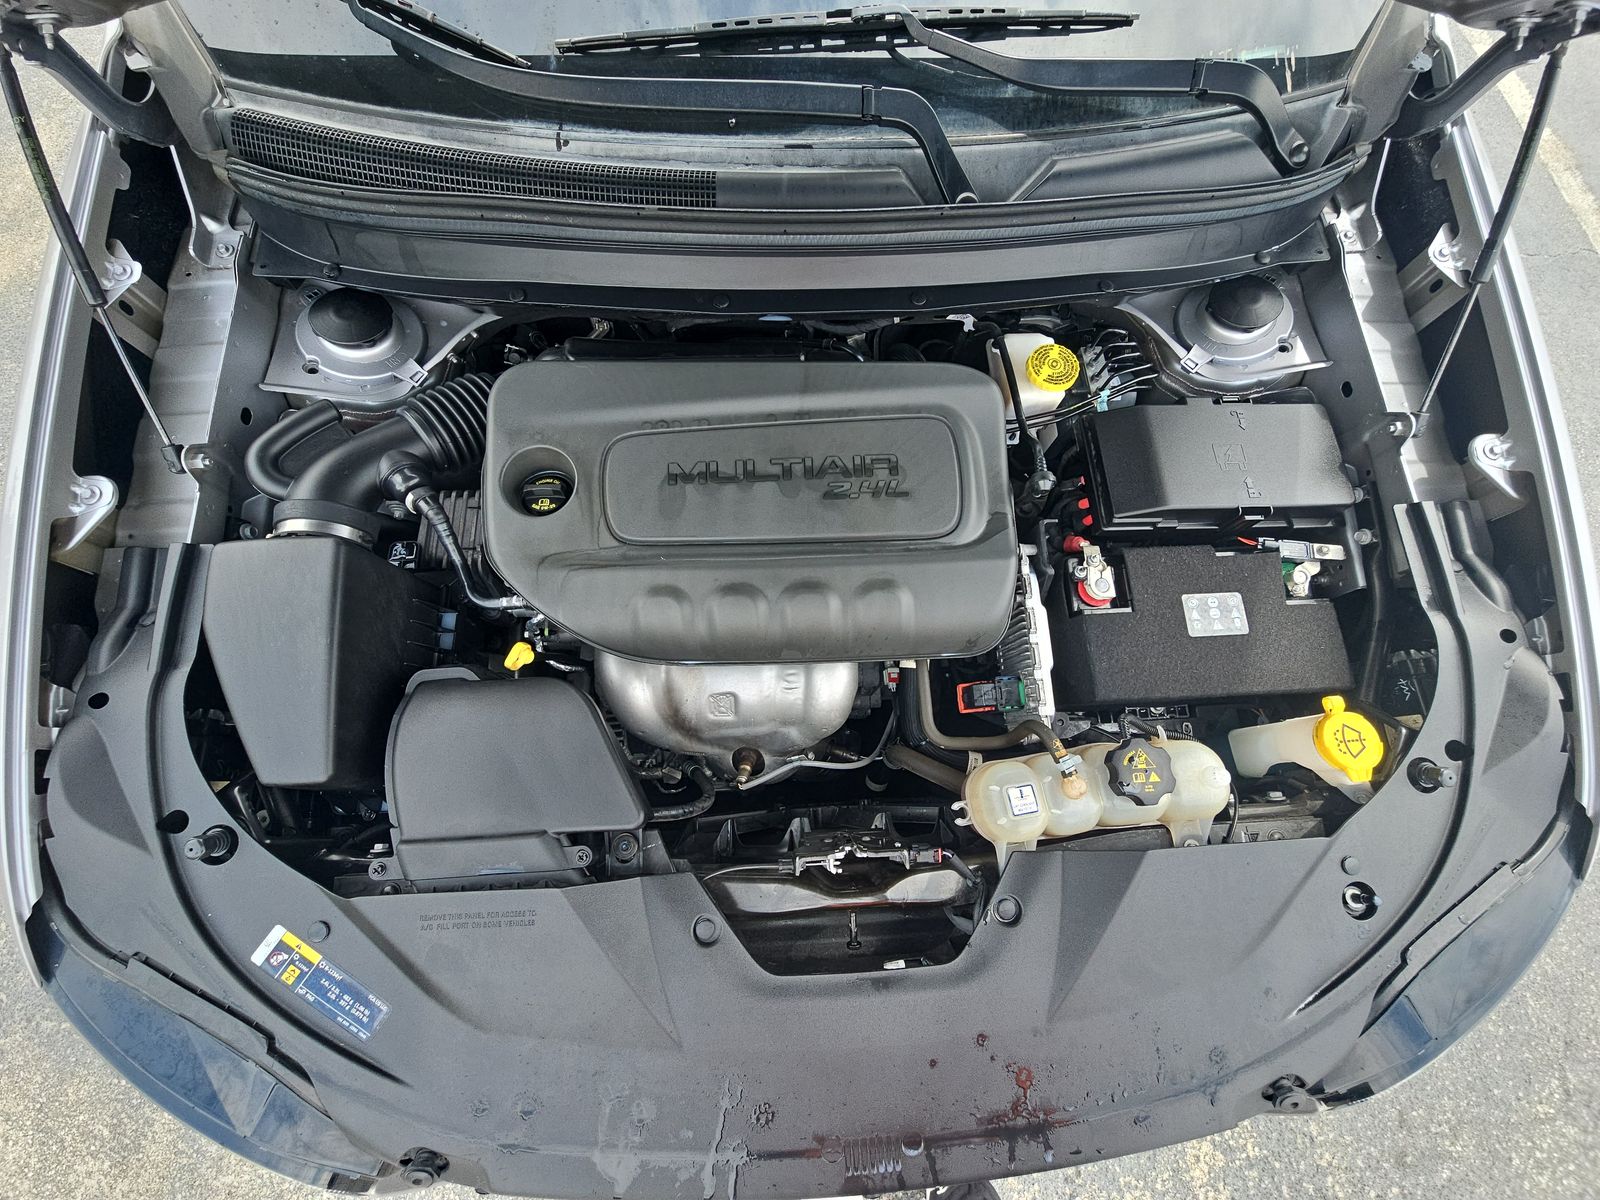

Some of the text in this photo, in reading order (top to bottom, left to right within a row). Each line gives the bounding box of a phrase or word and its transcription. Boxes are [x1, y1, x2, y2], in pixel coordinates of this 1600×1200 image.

[667, 453, 899, 486] MULTIAIR
[822, 479, 909, 500] 2.4L
[420, 914, 447, 922] REMOVE
[464, 912, 486, 920] PANEL
[501, 910, 526, 918] ACCESS
[452, 922, 469, 930] PORT
[484, 920, 502, 928] SOME
[504, 920, 536, 928] VEHICLES
